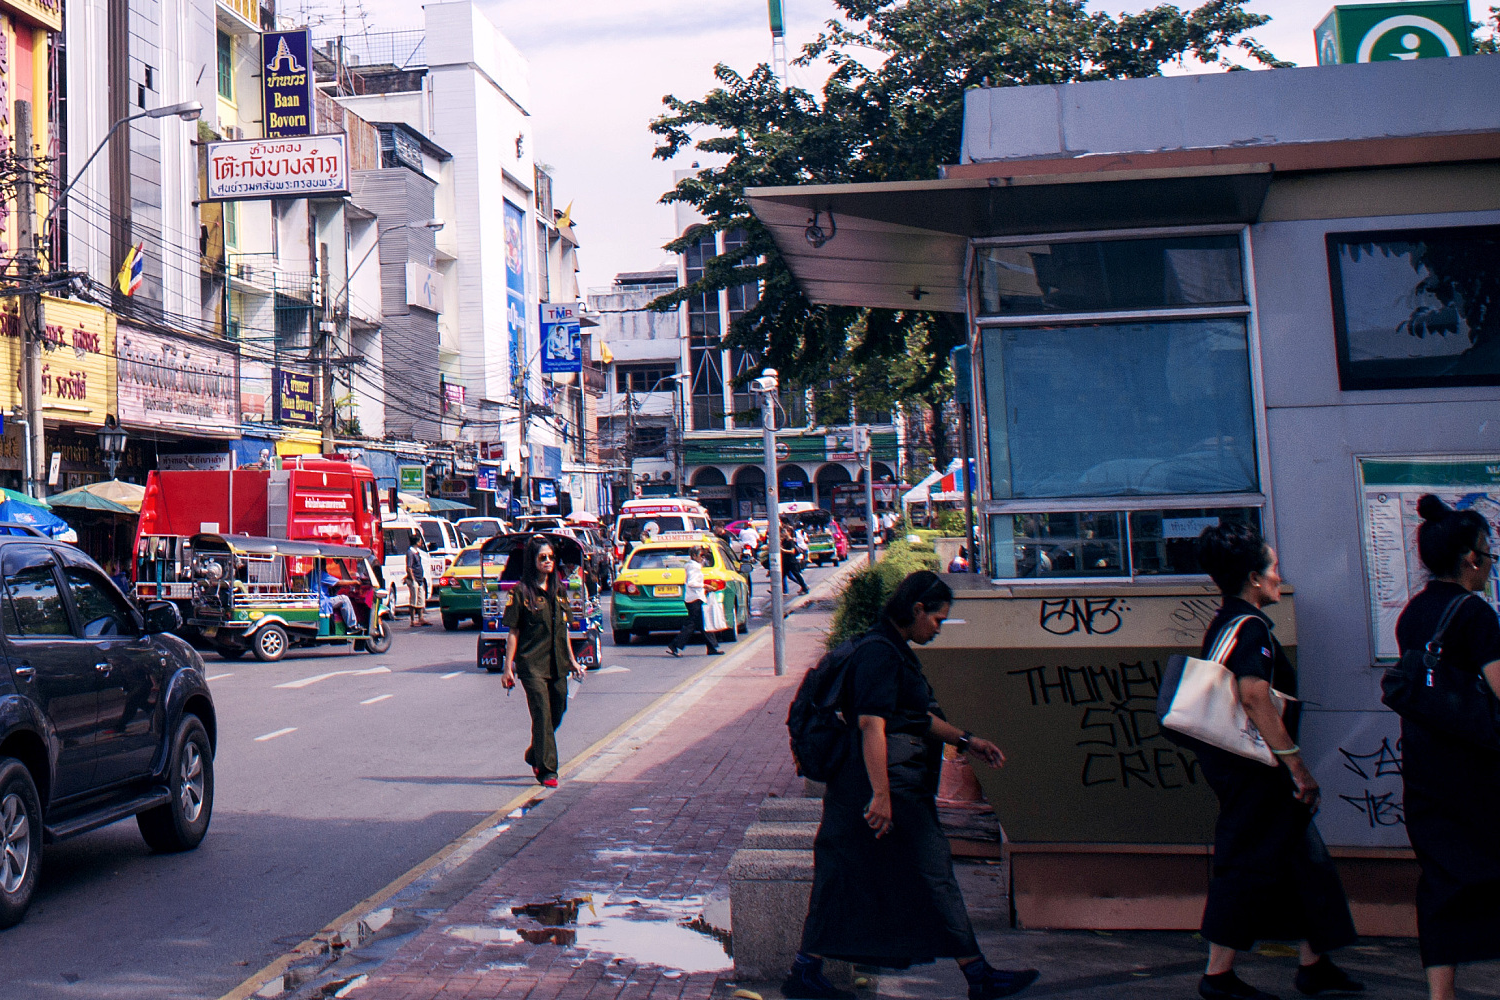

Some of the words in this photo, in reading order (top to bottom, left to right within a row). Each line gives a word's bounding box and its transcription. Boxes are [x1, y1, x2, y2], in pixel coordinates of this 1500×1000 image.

[267, 72, 307, 88] บ้านบวร
[273, 92, 300, 108] Baan
[269, 112, 307, 129] Bovorn
[249, 142, 302, 156] ห้างทอง
[547, 306, 573, 319] TMB
